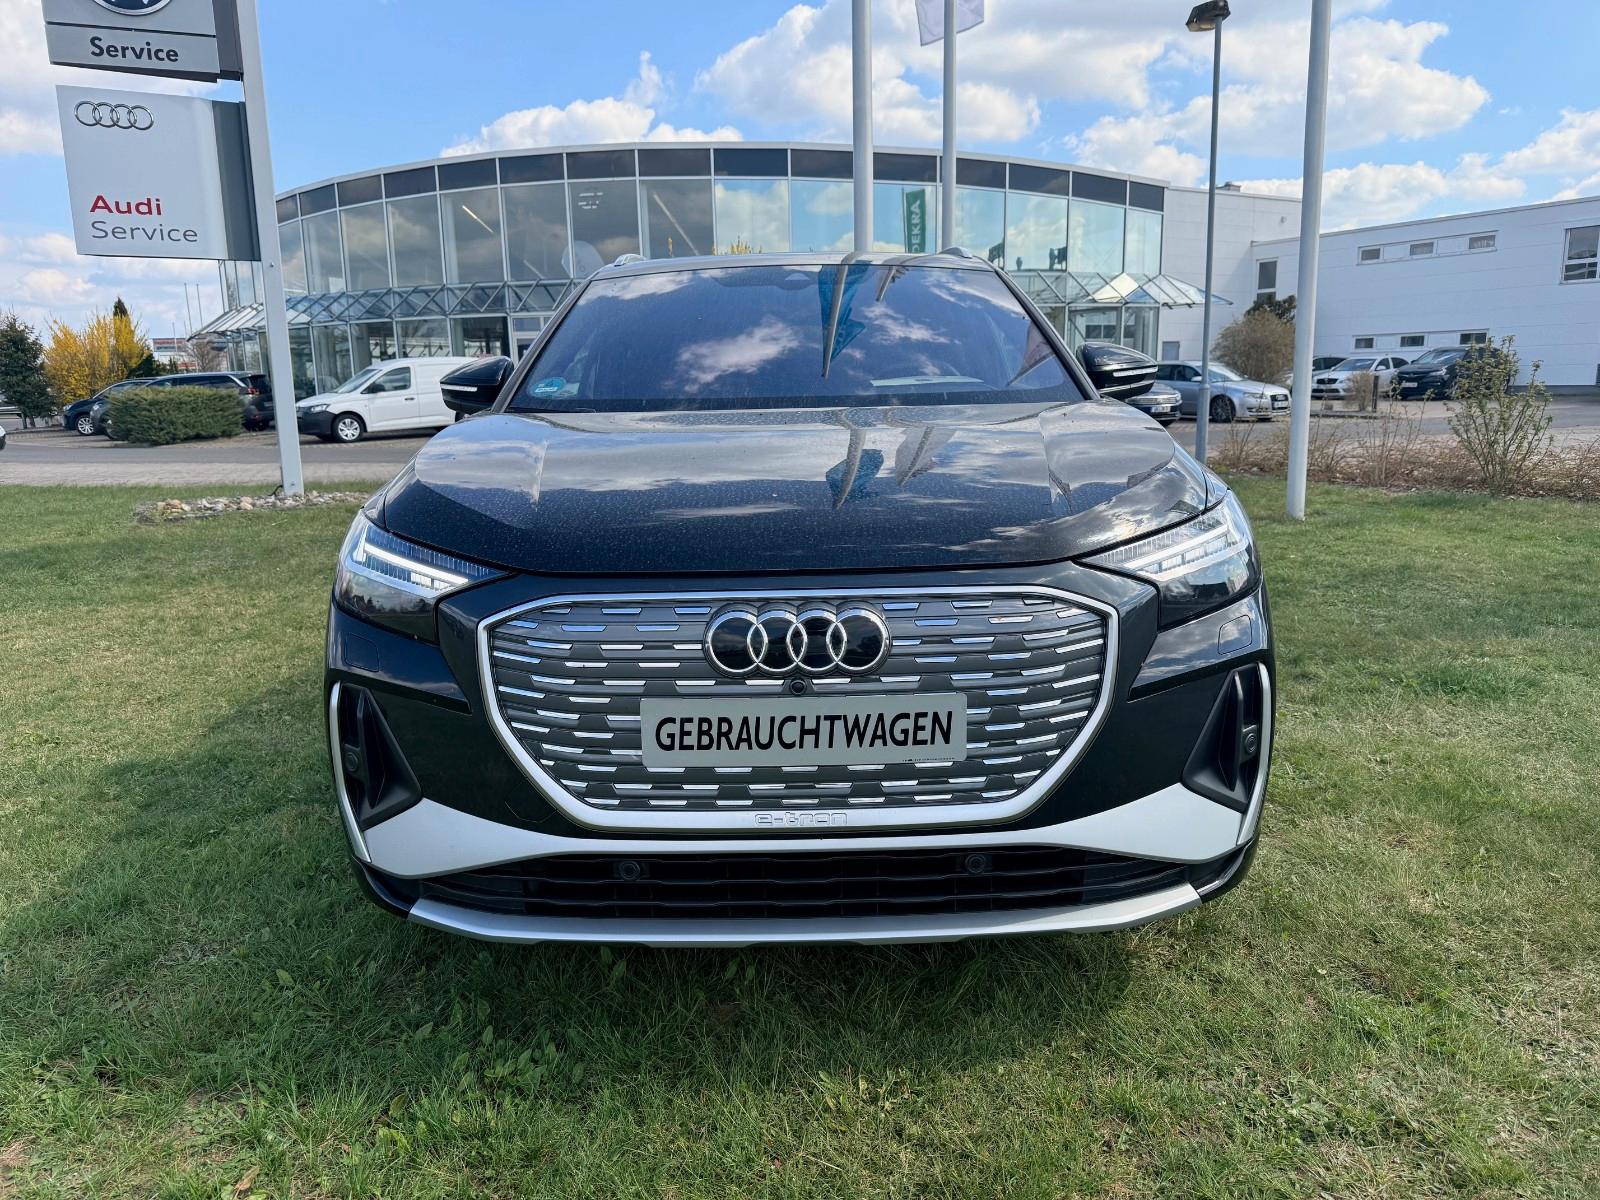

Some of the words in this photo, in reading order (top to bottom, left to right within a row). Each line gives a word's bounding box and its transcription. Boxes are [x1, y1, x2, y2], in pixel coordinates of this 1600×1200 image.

[89, 36, 179, 62] Service
[89, 194, 162, 216] Audi
[91, 220, 198, 243] Service
[655, 710, 953, 752] GEBRAUCHTWAGEN
[754, 811, 847, 827] e-tron
